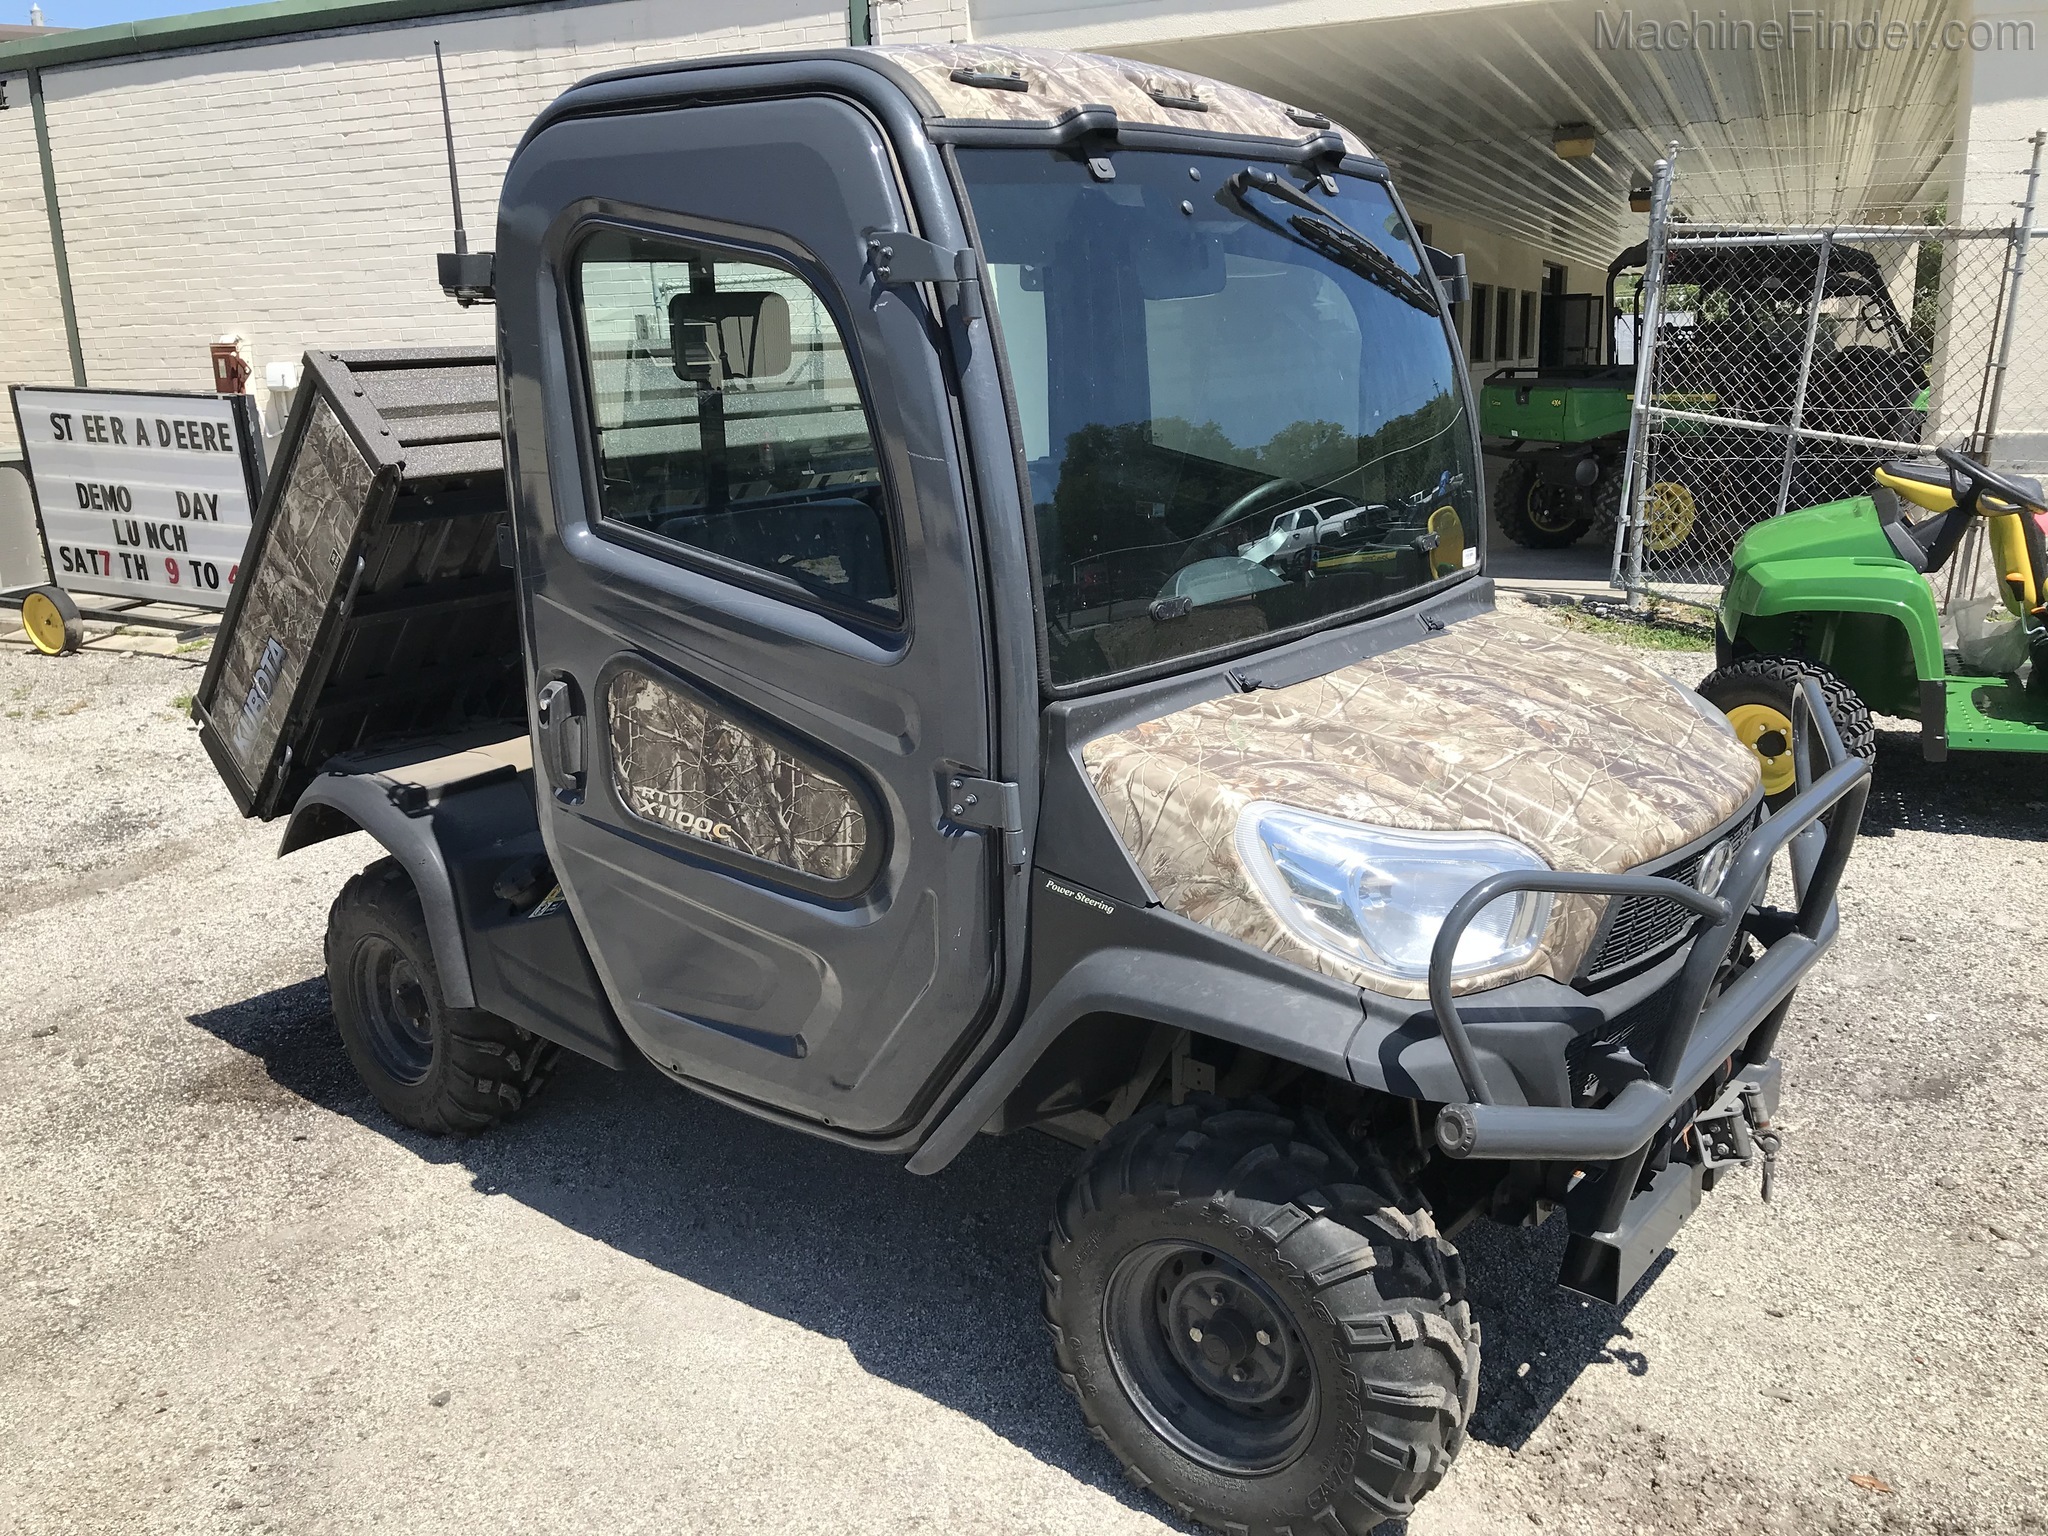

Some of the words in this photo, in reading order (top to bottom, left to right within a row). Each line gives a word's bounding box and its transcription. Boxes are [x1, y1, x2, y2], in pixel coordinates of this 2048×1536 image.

[136, 418, 150, 446] A
[155, 419, 233, 451] DEERE
[75, 482, 132, 513] DEMO
[175, 490, 218, 522] DAY
[112, 518, 188, 552] LUNCH
[165, 557, 180, 585] 9
[189, 560, 219, 590] TO
[233, 636, 287, 753] KUBOTA
[641, 786, 683, 808] RTV
[640, 799, 732, 839] X1100C
[1045, 880, 1075, 897] Power
[1074, 891, 1115, 915] Steering
